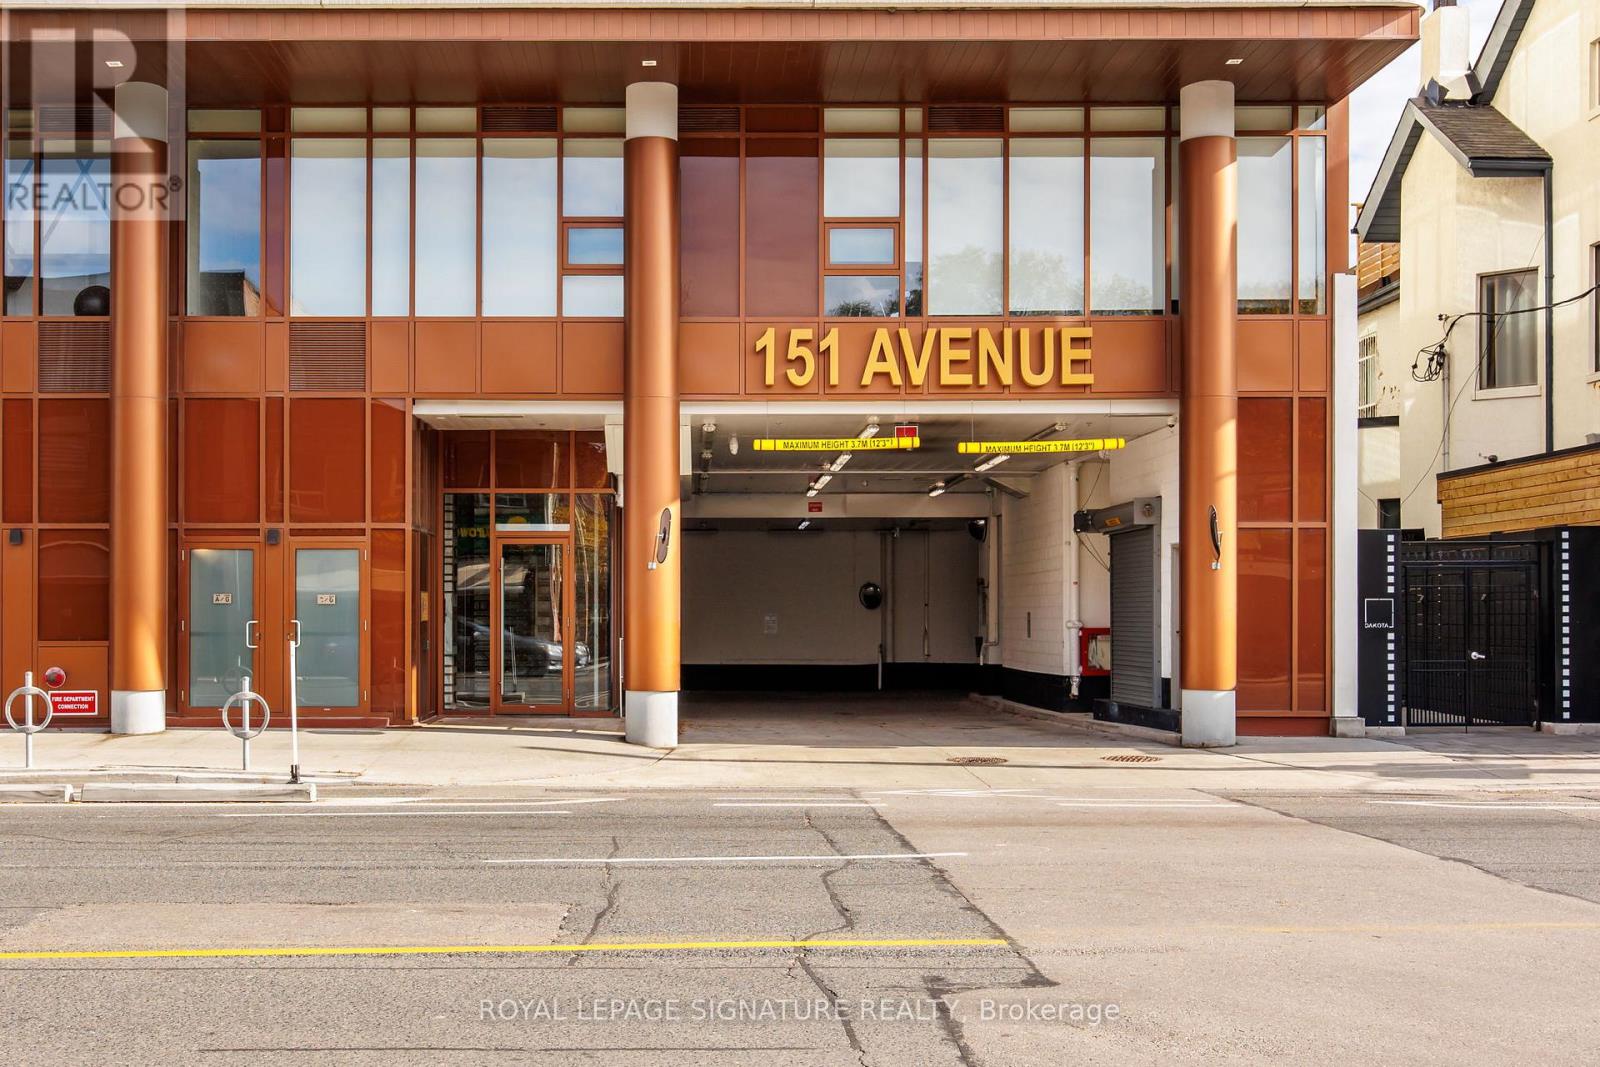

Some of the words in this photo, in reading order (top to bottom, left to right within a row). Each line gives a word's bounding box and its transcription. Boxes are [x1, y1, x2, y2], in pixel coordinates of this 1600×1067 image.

[755, 326, 841, 387] 151
[860, 326, 1095, 388] AVENUE
[782, 441, 820, 449] MAXIMUM
[821, 440, 849, 449] HEIGHT
[851, 439, 867, 448] 3.7M
[985, 445, 1022, 453] MAXIMUM
[1024, 444, 1051, 452] HEIGHT
